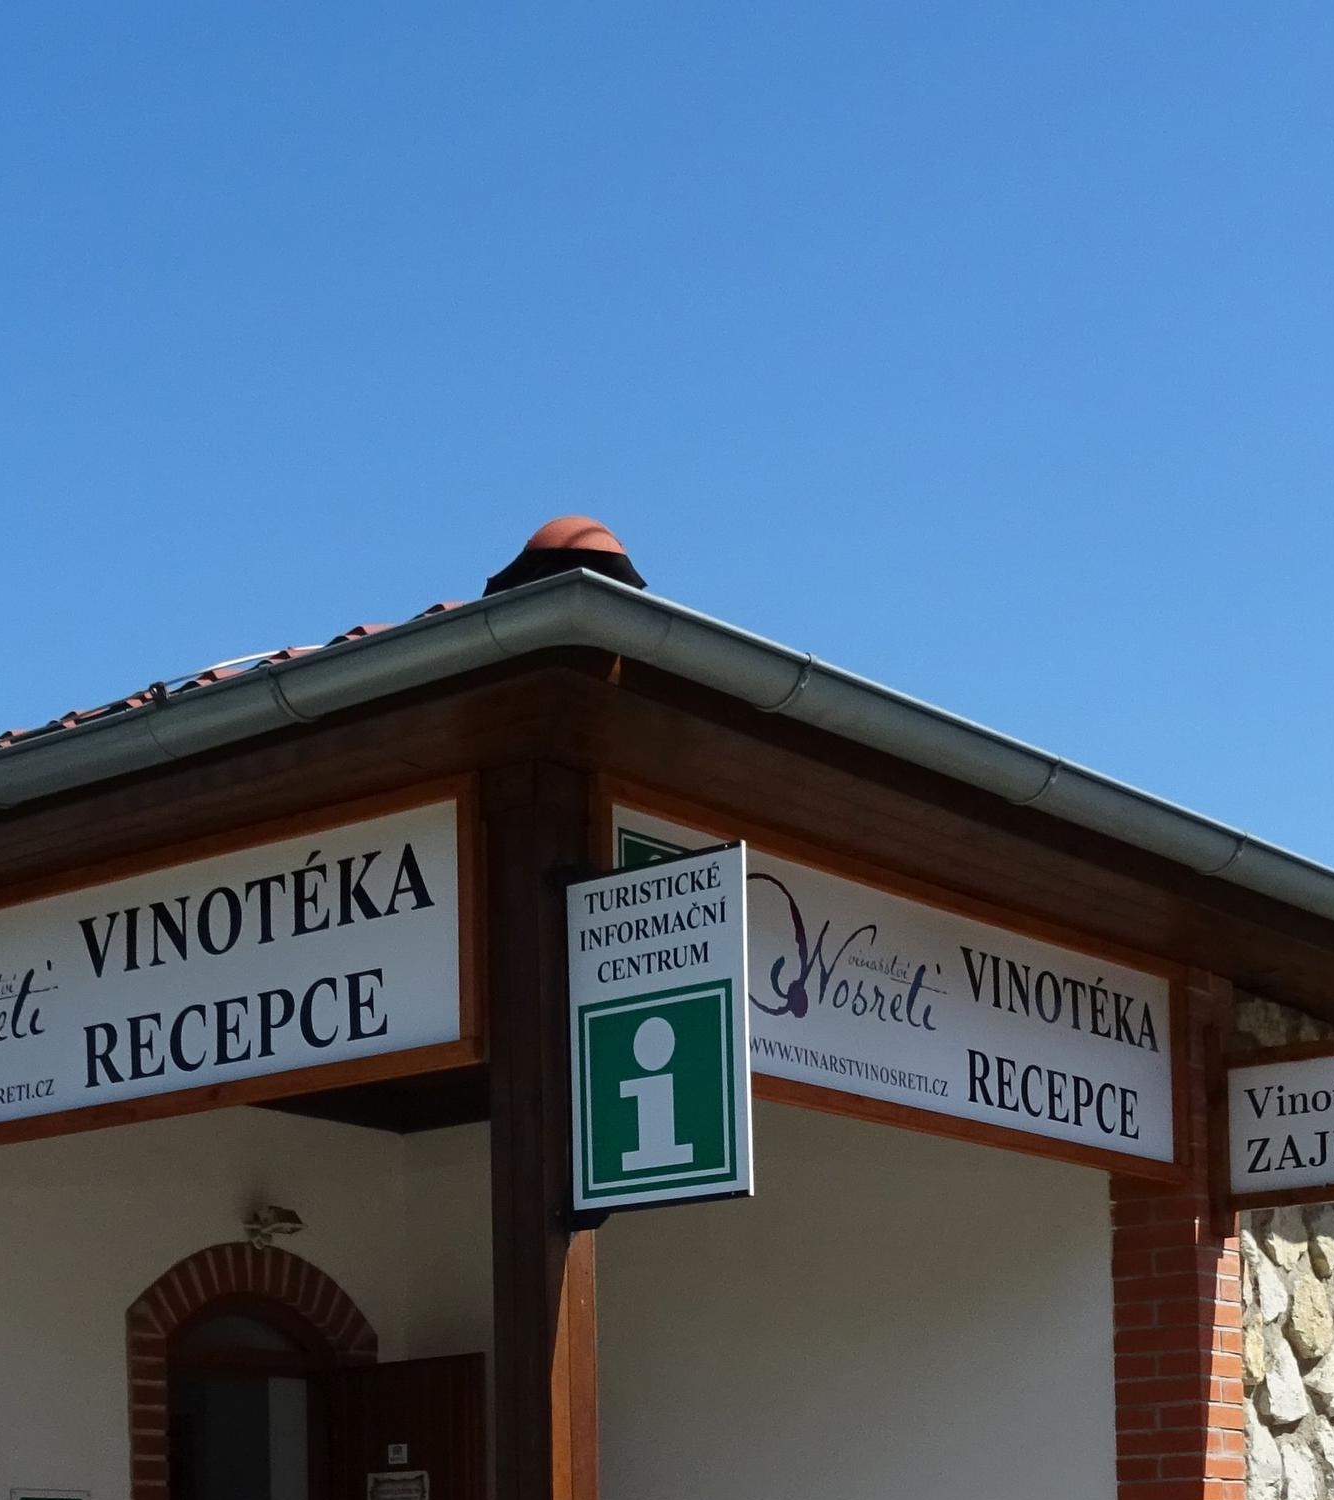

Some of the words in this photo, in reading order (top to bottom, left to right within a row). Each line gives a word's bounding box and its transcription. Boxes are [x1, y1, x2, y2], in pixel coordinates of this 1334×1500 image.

[78, 841, 436, 979] VINOTÉKA
[579, 896, 727, 952] INFORMAČNÍ
[584, 861, 722, 915] TURISTICKÉ
[596, 940, 709, 983] CENTRUM
[960, 945, 1160, 1053] VINOTÉKA
[83, 968, 389, 1088] RECEPCE
[967, 1048, 1140, 1141] RECEPCE
